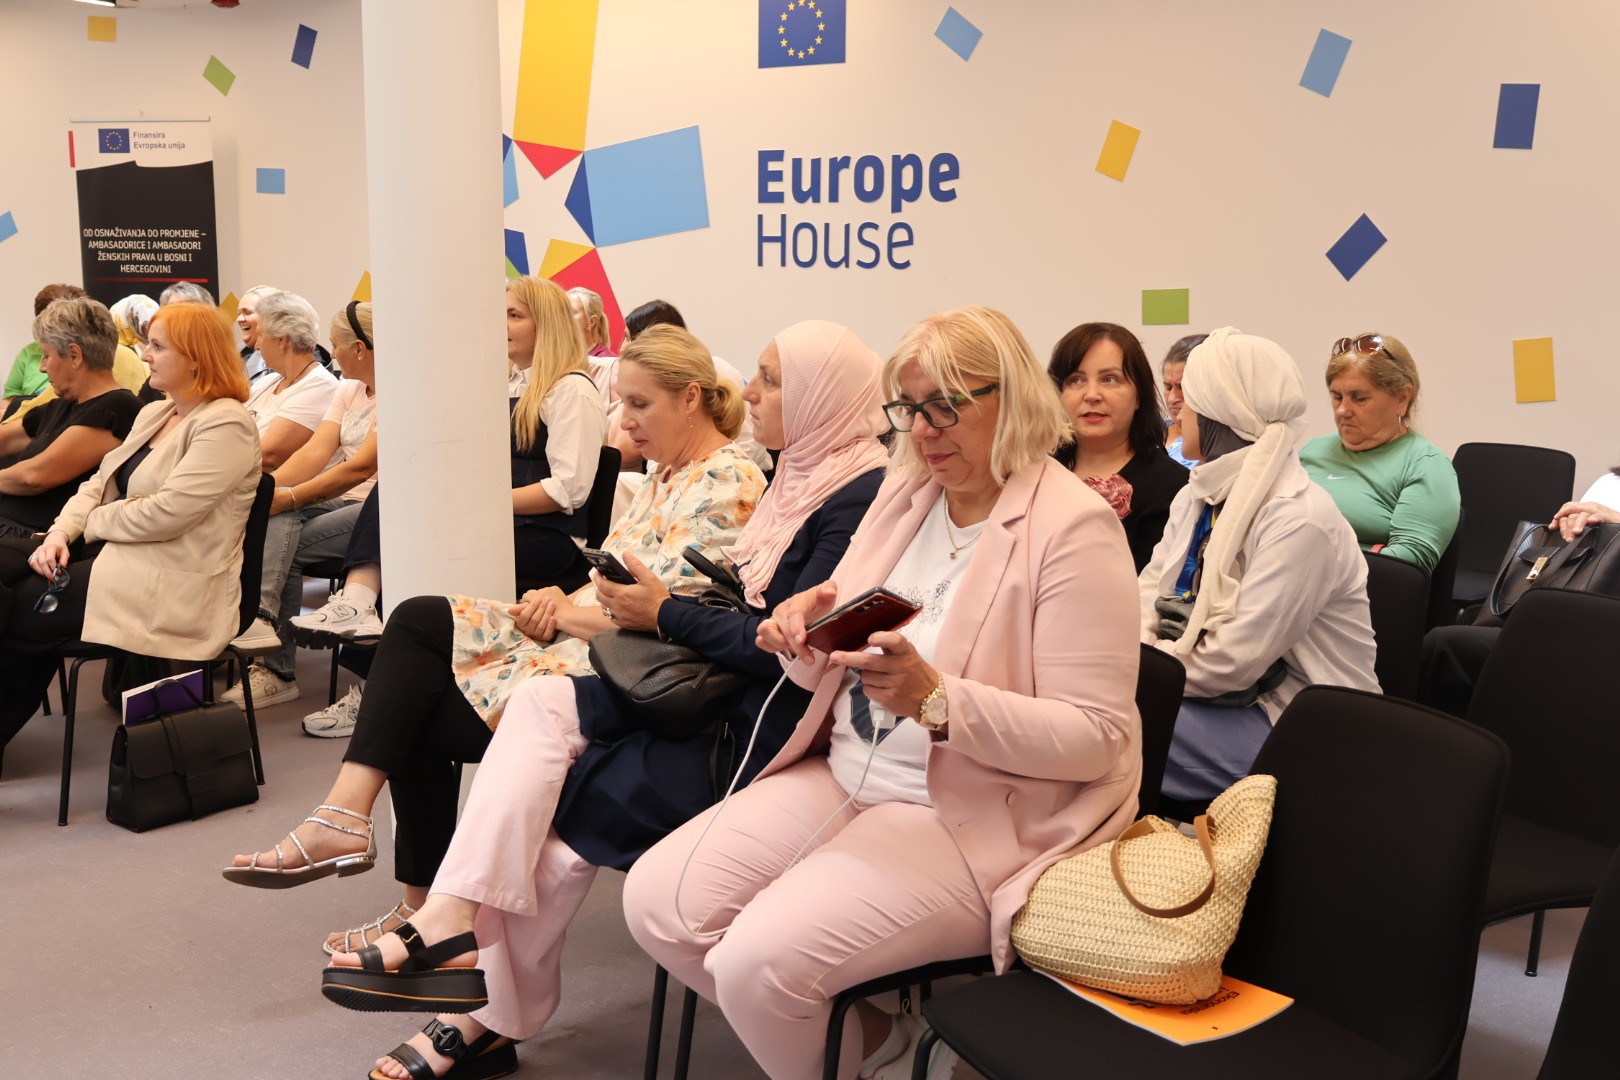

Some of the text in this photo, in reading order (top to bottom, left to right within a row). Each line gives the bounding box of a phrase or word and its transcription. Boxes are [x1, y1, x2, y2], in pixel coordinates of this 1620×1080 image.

[133, 131, 166, 139] Finansira
[133, 141, 186, 150] Evropska unija
[758, 150, 960, 214] Europe
[83, 228, 94, 238] OD
[94, 227, 147, 238] OSNAŽIVANJA
[147, 229, 159, 238] DO
[160, 229, 200, 238] PROMJENE
[88, 240, 146, 250] AMBASADORICE
[152, 241, 202, 250] AMBASADORI
[757, 213, 914, 270] House
[97, 250, 130, 261] ŽENSKIH
[131, 252, 156, 261] PRAVA
[157, 252, 163, 261] U
[164, 253, 187, 262] BOSNI
[120, 264, 172, 274] HERCEGOVINI
